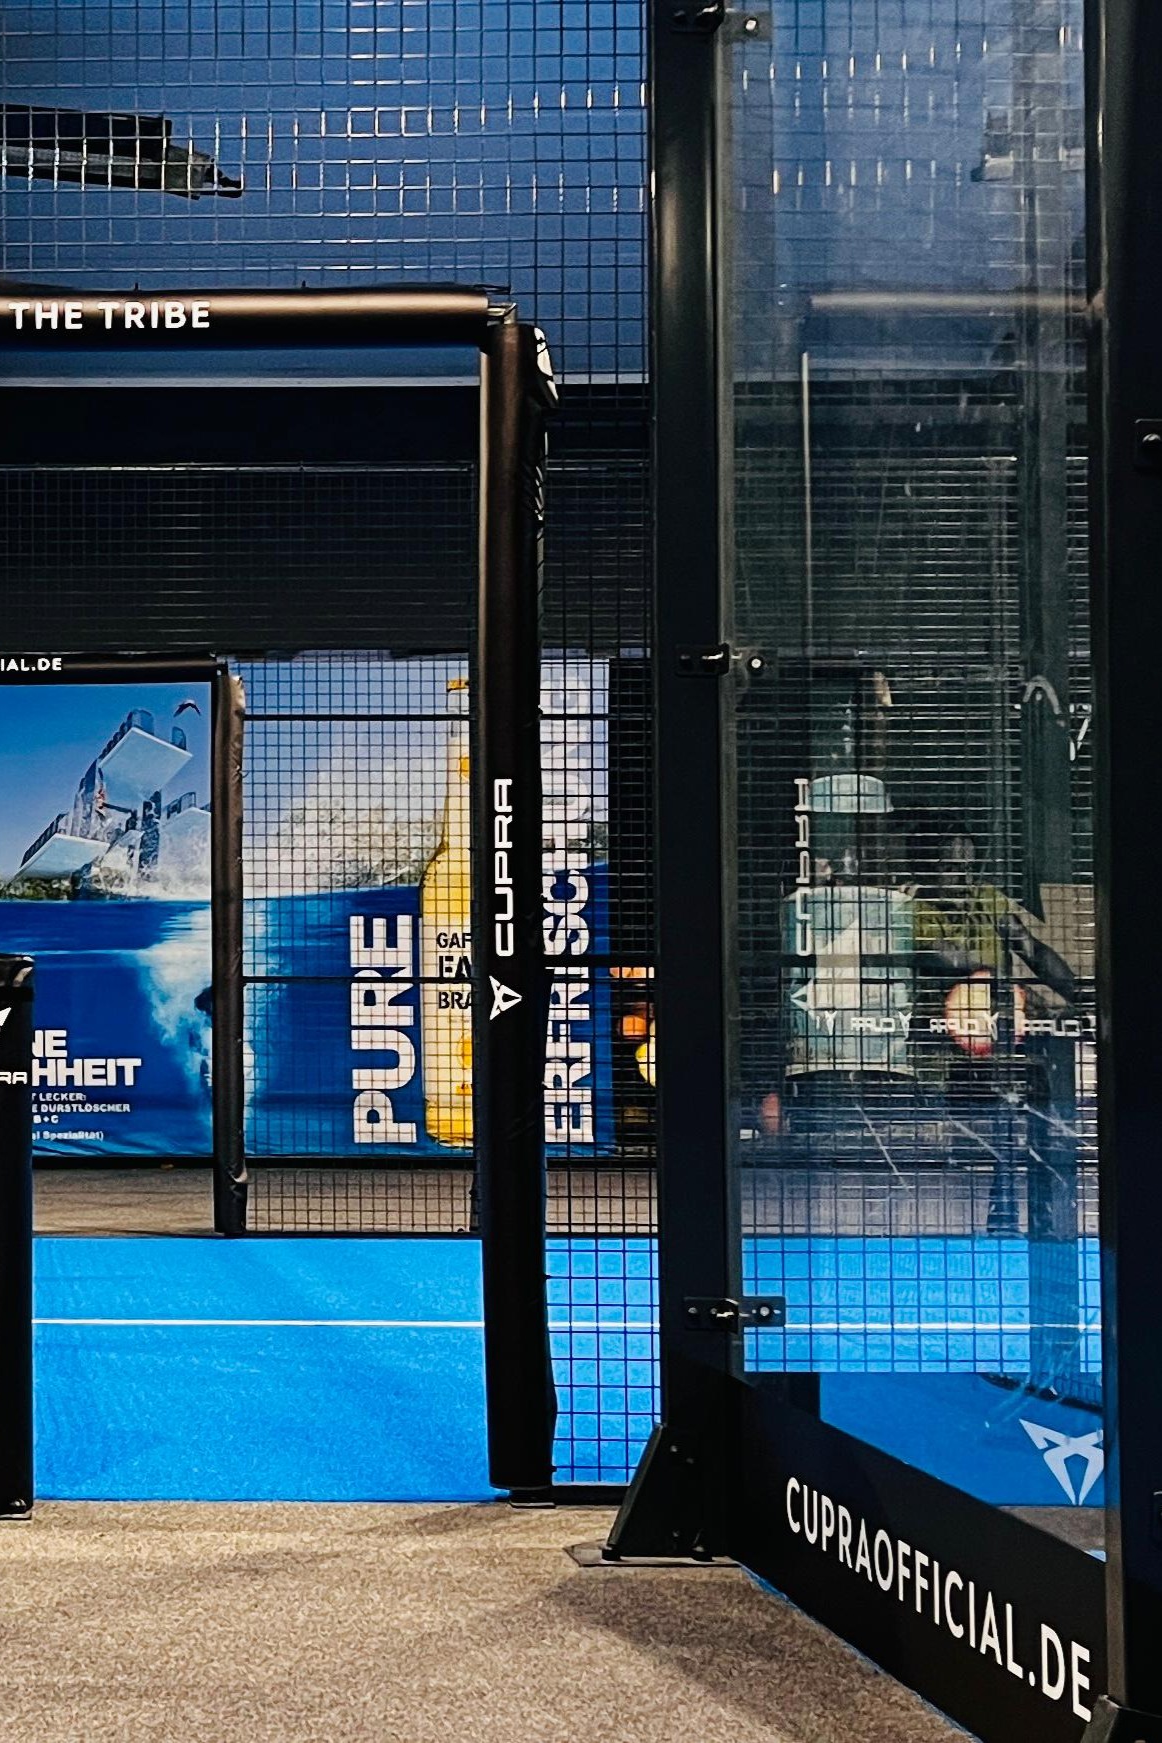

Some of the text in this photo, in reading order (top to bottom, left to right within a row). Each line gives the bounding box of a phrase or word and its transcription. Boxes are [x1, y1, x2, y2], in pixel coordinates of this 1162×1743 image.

[8, 301, 84, 330] THE
[98, 300, 212, 329] TRIBE
[494, 778, 514, 957] CUPRA
[349, 914, 417, 1144] PURE
[785, 1476, 1093, 1722] CUPRAOFFICIAL.DE
